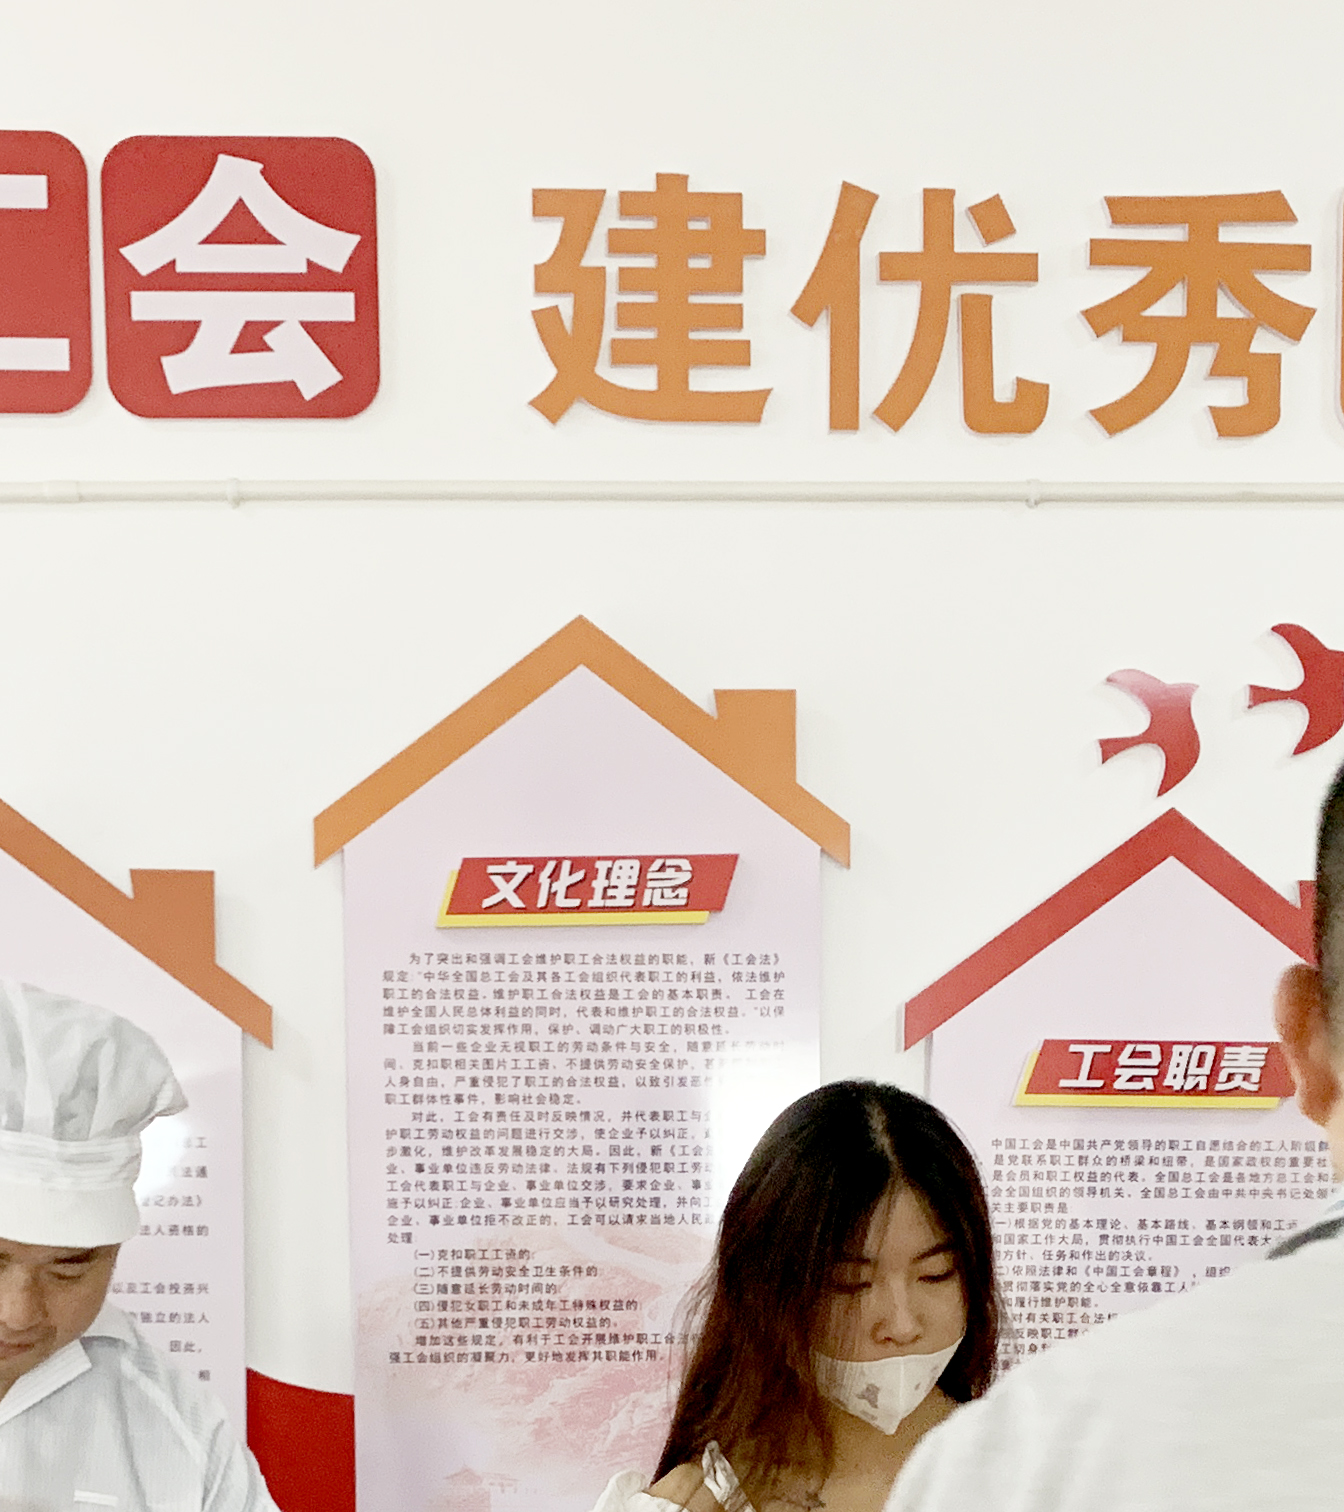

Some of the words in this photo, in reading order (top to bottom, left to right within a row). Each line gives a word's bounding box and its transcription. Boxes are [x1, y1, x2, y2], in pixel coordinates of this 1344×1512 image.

[481, 857, 693, 910] 文化理念
[1058, 1044, 1268, 1092] 工会职责
[991, 1186, 1337, 1200] 会全国组织的领导机关。全国总工会由中共中央书记处领
[993, 1233, 1286, 1247] 和国家工作大局，贯彻执行中国工会全国代表大
